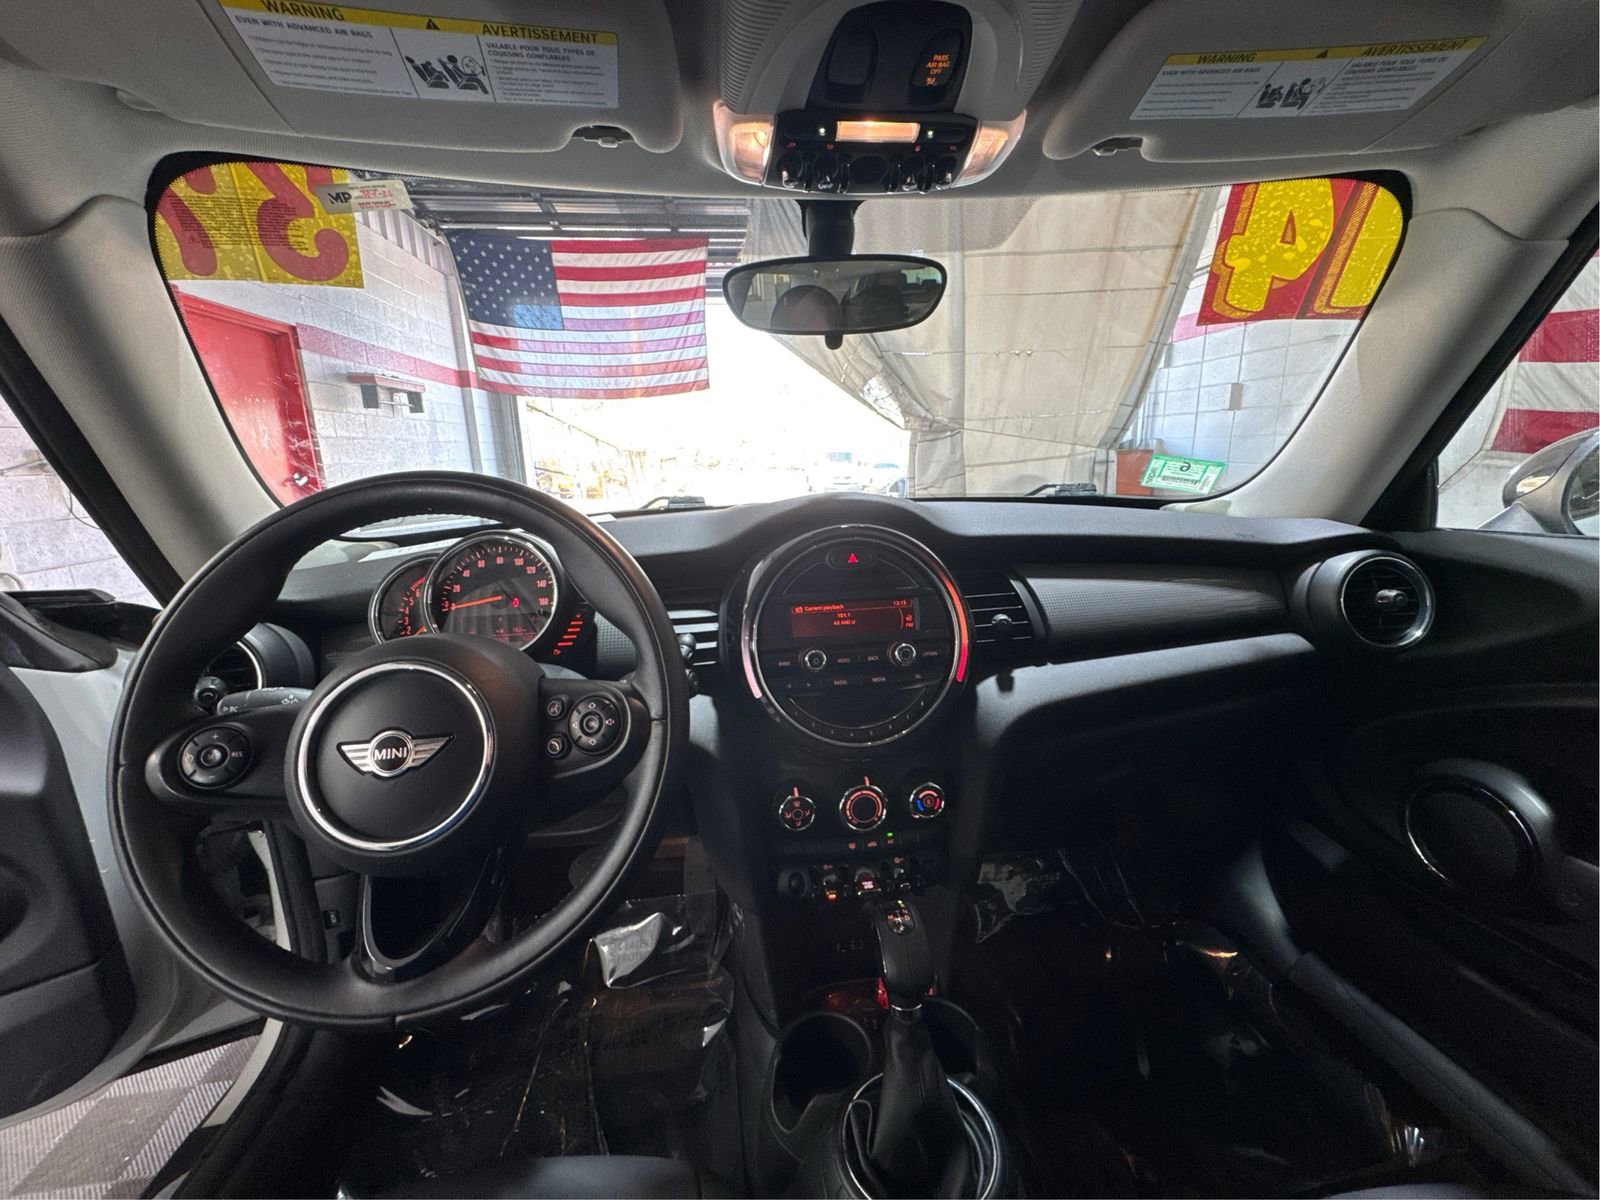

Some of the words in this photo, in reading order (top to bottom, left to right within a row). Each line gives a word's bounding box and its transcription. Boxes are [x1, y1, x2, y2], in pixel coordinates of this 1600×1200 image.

[262, 0, 345, 21] WARNING
[234, 15, 260, 26] EVEN
[261, 18, 284, 29] WITH
[286, 22, 333, 35] ADVANCED
[334, 28, 348, 36] AIR
[350, 29, 373, 38] BAGS
[482, 24, 598, 44] AVERTISSEMENT
[485, 42, 517, 51] VALABLE
[519, 44, 540, 52] POUR
[541, 46, 561, 54] TOUS
[563, 47, 585, 56] TYPES
[1360, 39, 1469, 57] AVERTISSEMENT
[487, 49, 525, 59] COUSSINS
[1196, 52, 1258, 64] WARNING
[514, 558, 524, 566] 100
[462, 569, 470, 577] 40
[526, 566, 536, 574] 120
[536, 579, 547, 588] 140
[409, 597, 414, 606] 5
[538, 597, 549, 606] 160
[804, 604, 823, 612] Current
[374, 747, 408, 760] MINI
